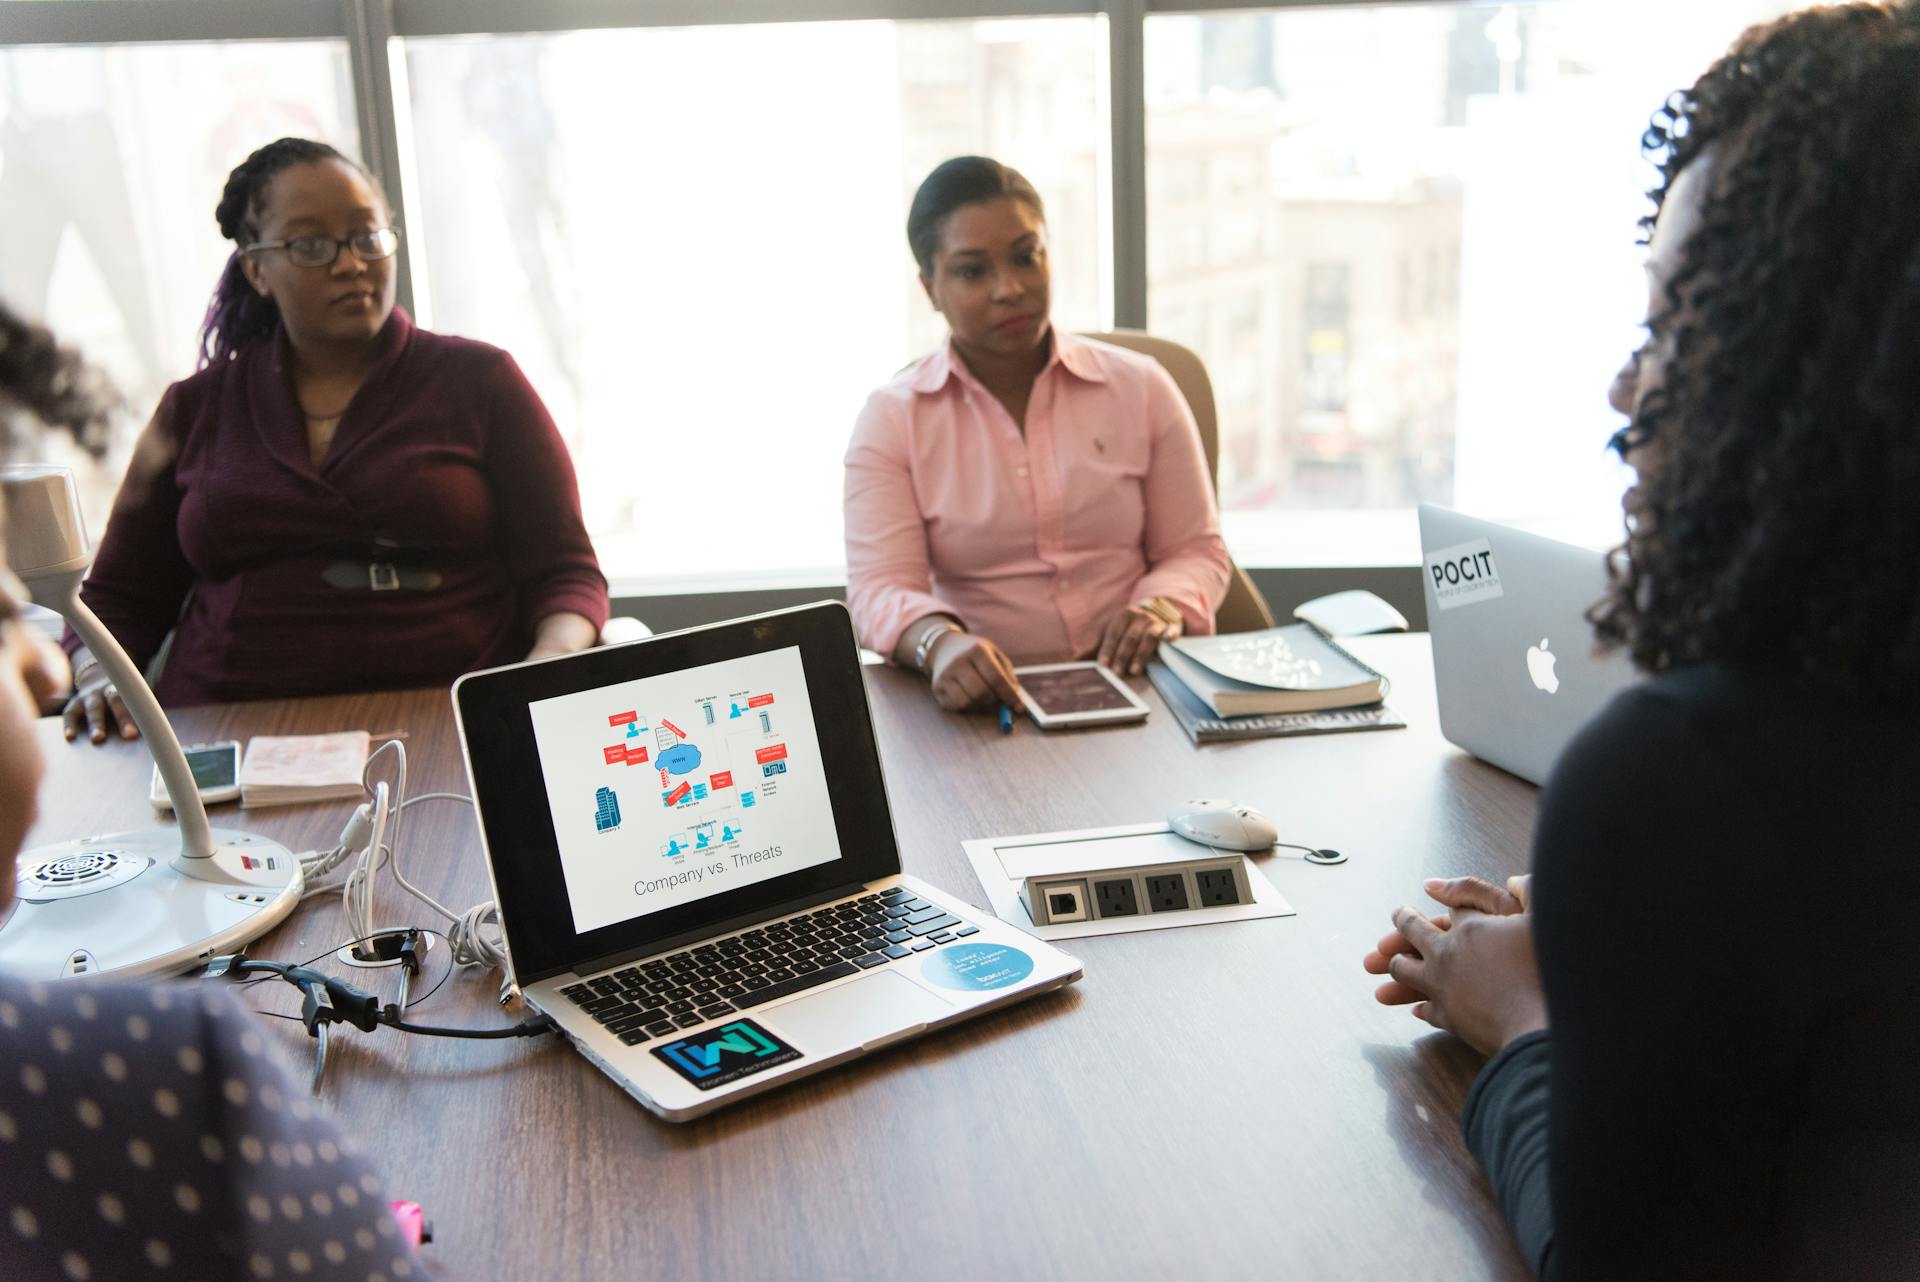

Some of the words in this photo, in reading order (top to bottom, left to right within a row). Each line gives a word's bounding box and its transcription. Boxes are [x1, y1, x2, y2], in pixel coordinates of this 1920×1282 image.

[1431, 550, 1491, 588] POCIT
[634, 867, 703, 896] Company
[707, 862, 728, 876] vs.
[731, 845, 783, 869] Threats
